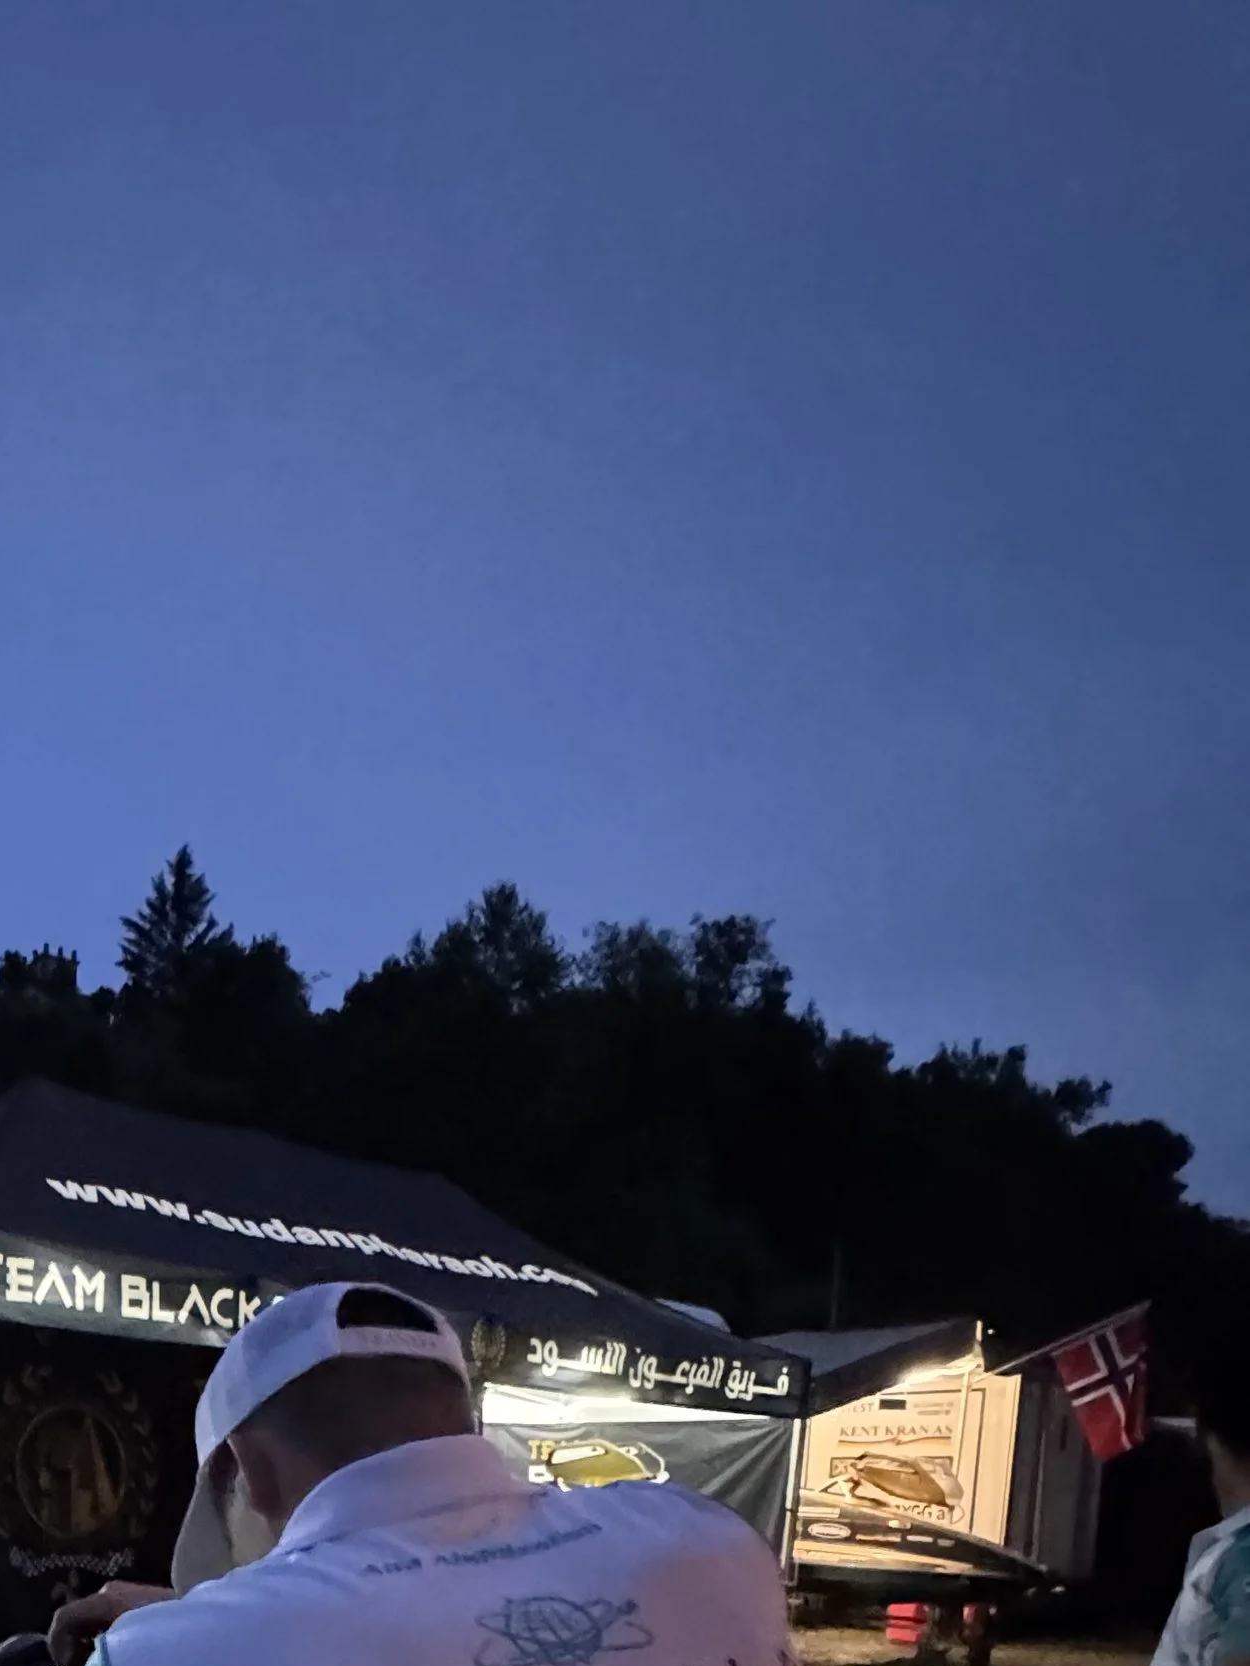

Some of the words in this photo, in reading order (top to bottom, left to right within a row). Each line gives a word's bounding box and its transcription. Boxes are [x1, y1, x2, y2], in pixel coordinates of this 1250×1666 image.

[120, 1273, 262, 1330] BLACK
[724, 1360, 790, 1401] فريق
[839, 1425, 879, 1438] KENT
[885, 1424, 929, 1437] KRAN
[933, 1424, 953, 1435] AS
